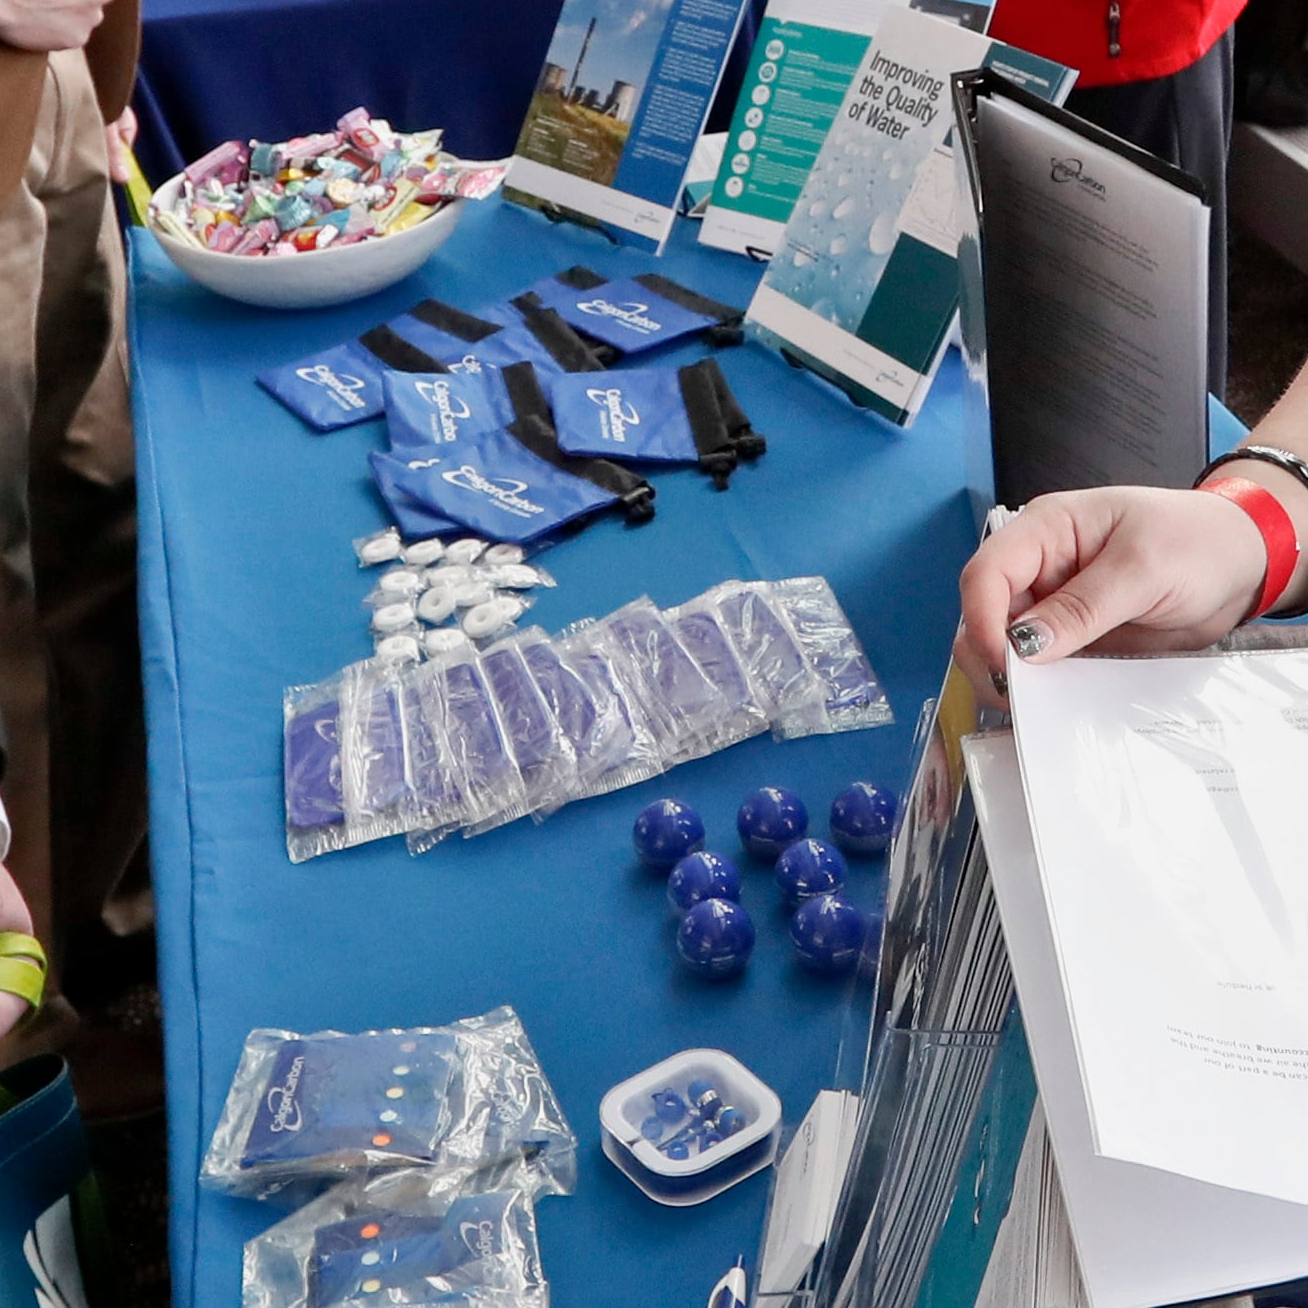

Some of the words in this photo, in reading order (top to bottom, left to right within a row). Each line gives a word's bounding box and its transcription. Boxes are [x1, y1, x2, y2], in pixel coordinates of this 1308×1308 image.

[869, 49, 944, 101] Improving
[859, 75, 884, 100] the
[885, 85, 939, 127] Quality
[848, 101, 868, 121] of
[865, 104, 910, 140] Water
[434, 380, 457, 441] CalgonCarbo
[460, 465, 545, 514] CalgonCarbon
[1197, 1034, 1214, 1044] our
[1204, 1058, 1221, 1066] our
[1212, 1049, 1254, 1063] breathe
[1224, 1062, 1235, 1070] of
[1238, 1065, 1260, 1074] part
[1272, 1071, 1286, 1079] be
[1288, 1073, 1308, 1081] can
[270, 1056, 304, 1132] CalgonCarbon
